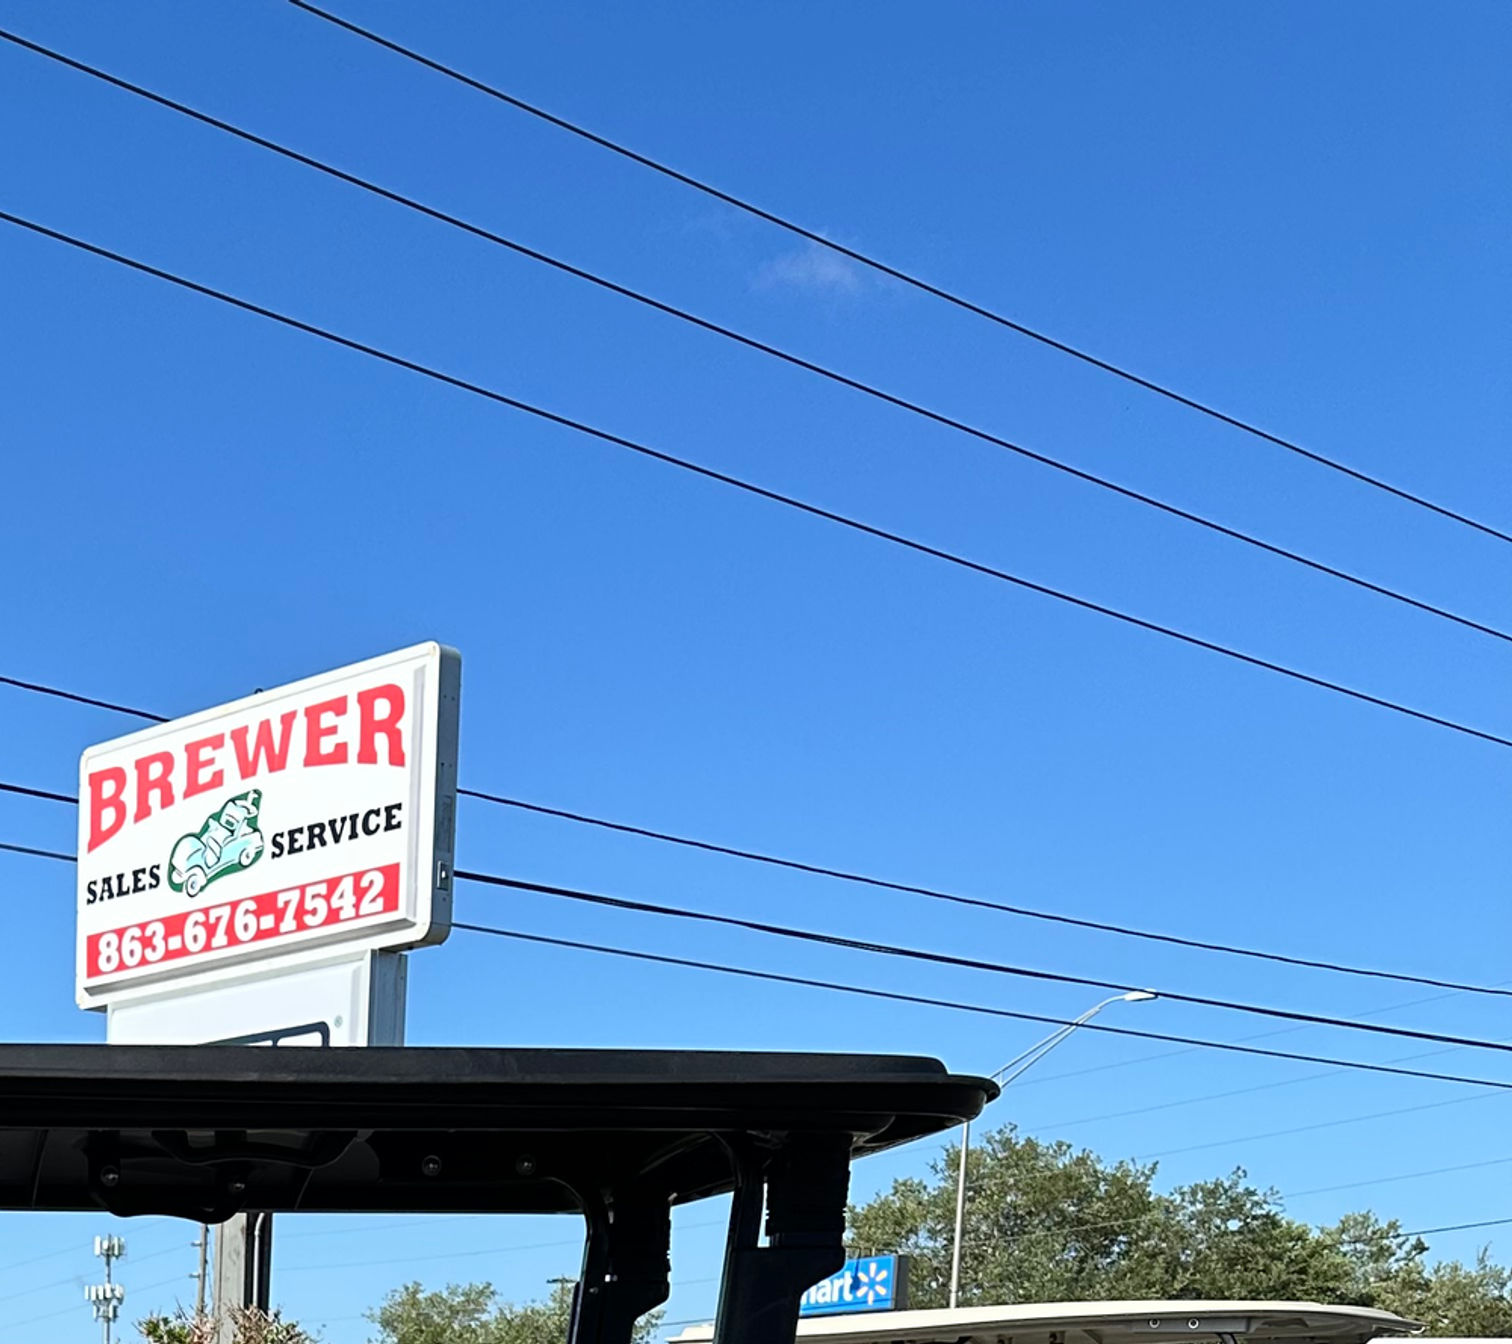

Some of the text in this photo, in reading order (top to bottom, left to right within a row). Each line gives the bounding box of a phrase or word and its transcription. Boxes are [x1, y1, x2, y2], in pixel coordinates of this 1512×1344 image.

[89, 684, 405, 854] BREWER
[86, 803, 403, 904] SALES SERVICE
[97, 870, 385, 973] 863-676-7542
